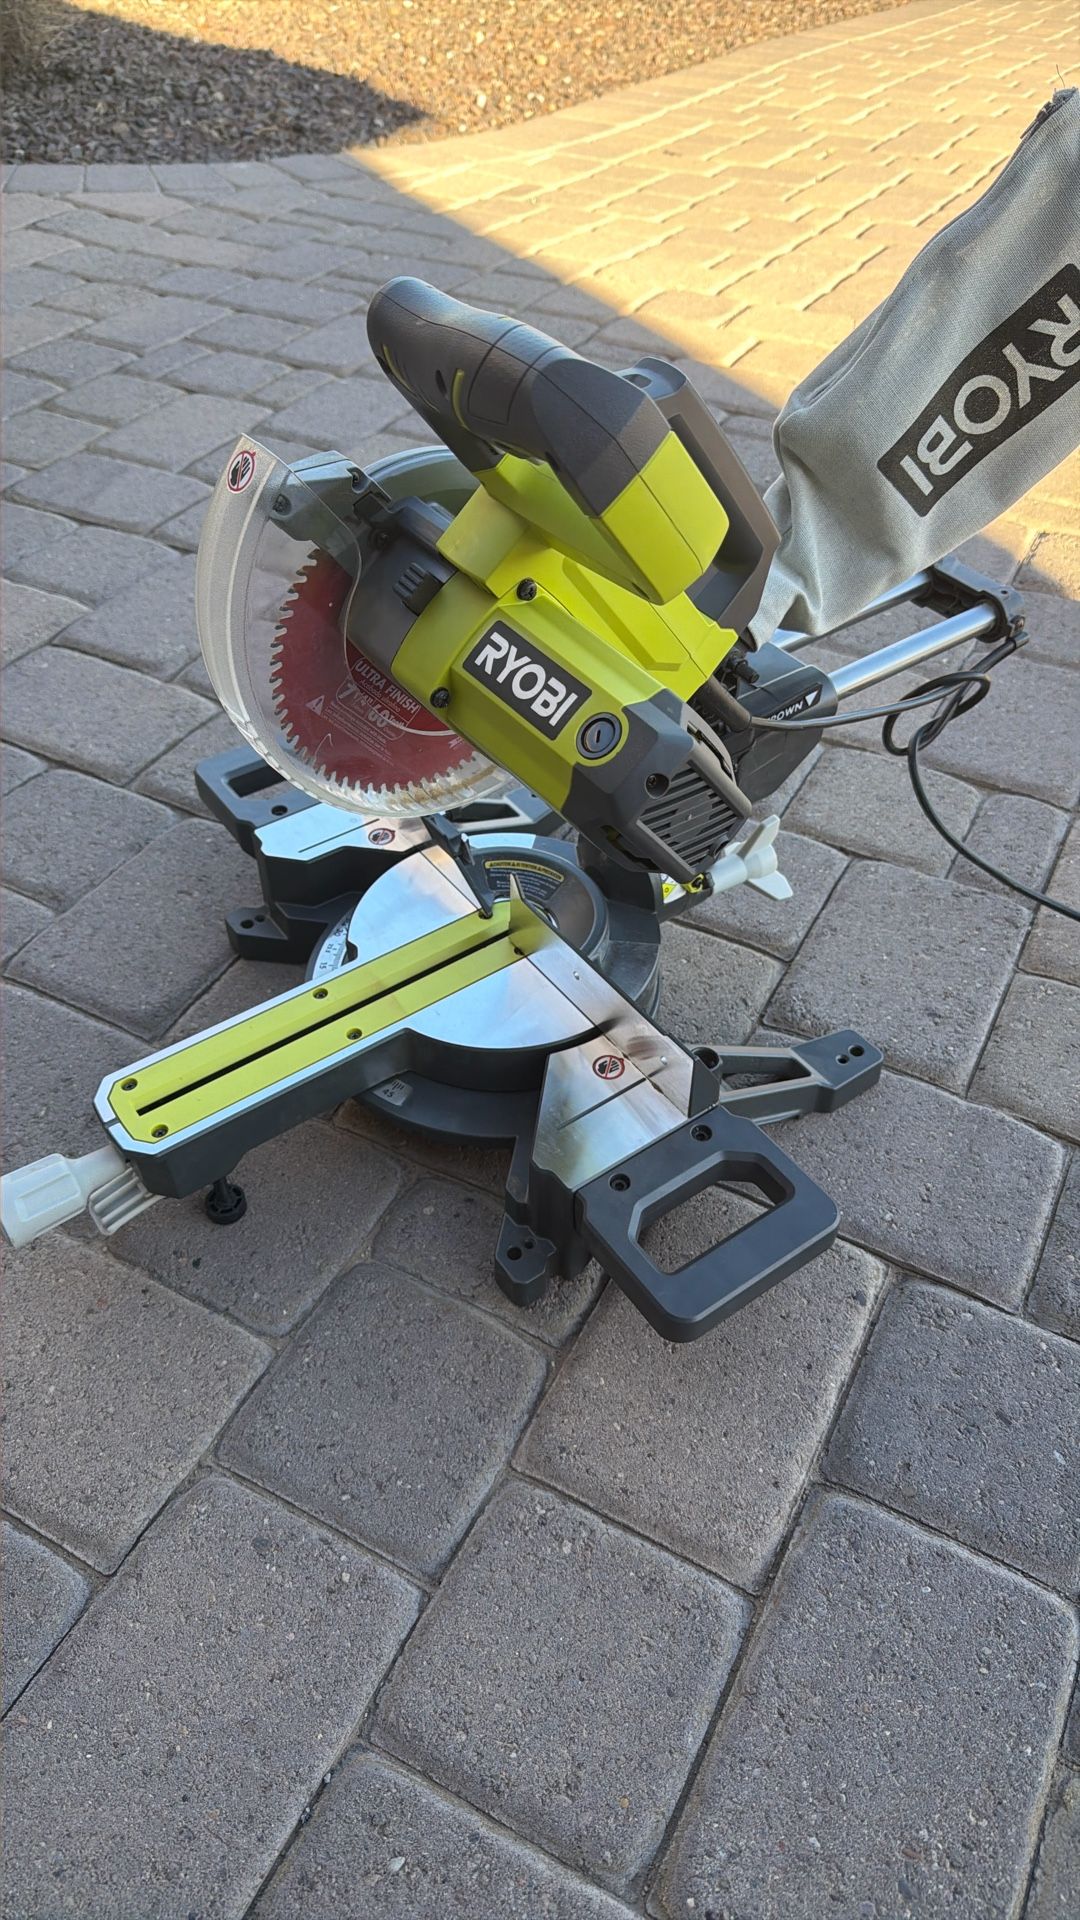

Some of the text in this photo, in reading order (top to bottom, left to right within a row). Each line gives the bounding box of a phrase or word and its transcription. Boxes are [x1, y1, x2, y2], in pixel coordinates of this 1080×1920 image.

[900, 293, 1080, 497] RYOBI
[355, 660, 385, 690] ULTRA
[385, 685, 421, 714] FINISH
[474, 631, 579, 727] RYOBI
